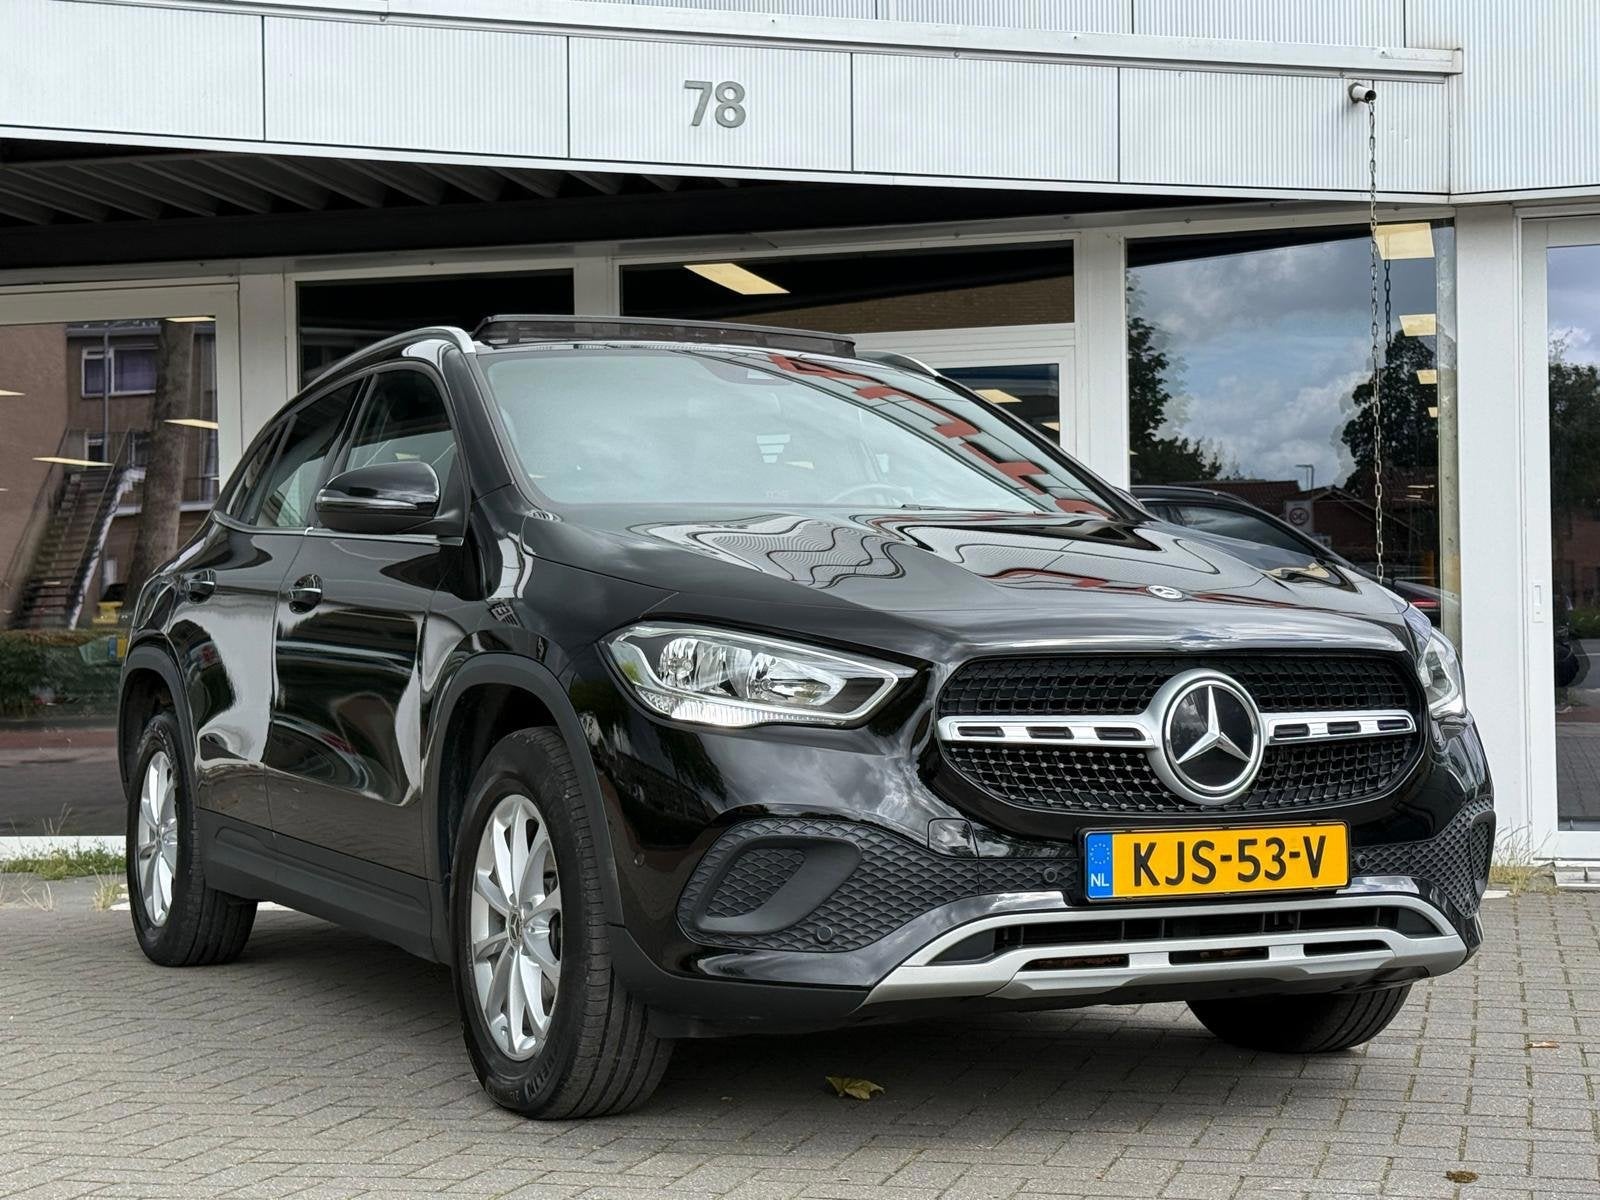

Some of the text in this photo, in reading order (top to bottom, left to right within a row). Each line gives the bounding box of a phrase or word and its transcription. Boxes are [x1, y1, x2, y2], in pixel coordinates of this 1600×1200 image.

[684, 80, 746, 128] 78
[1090, 873, 1110, 888] NL
[1133, 835, 1326, 887] KJS-53-V
